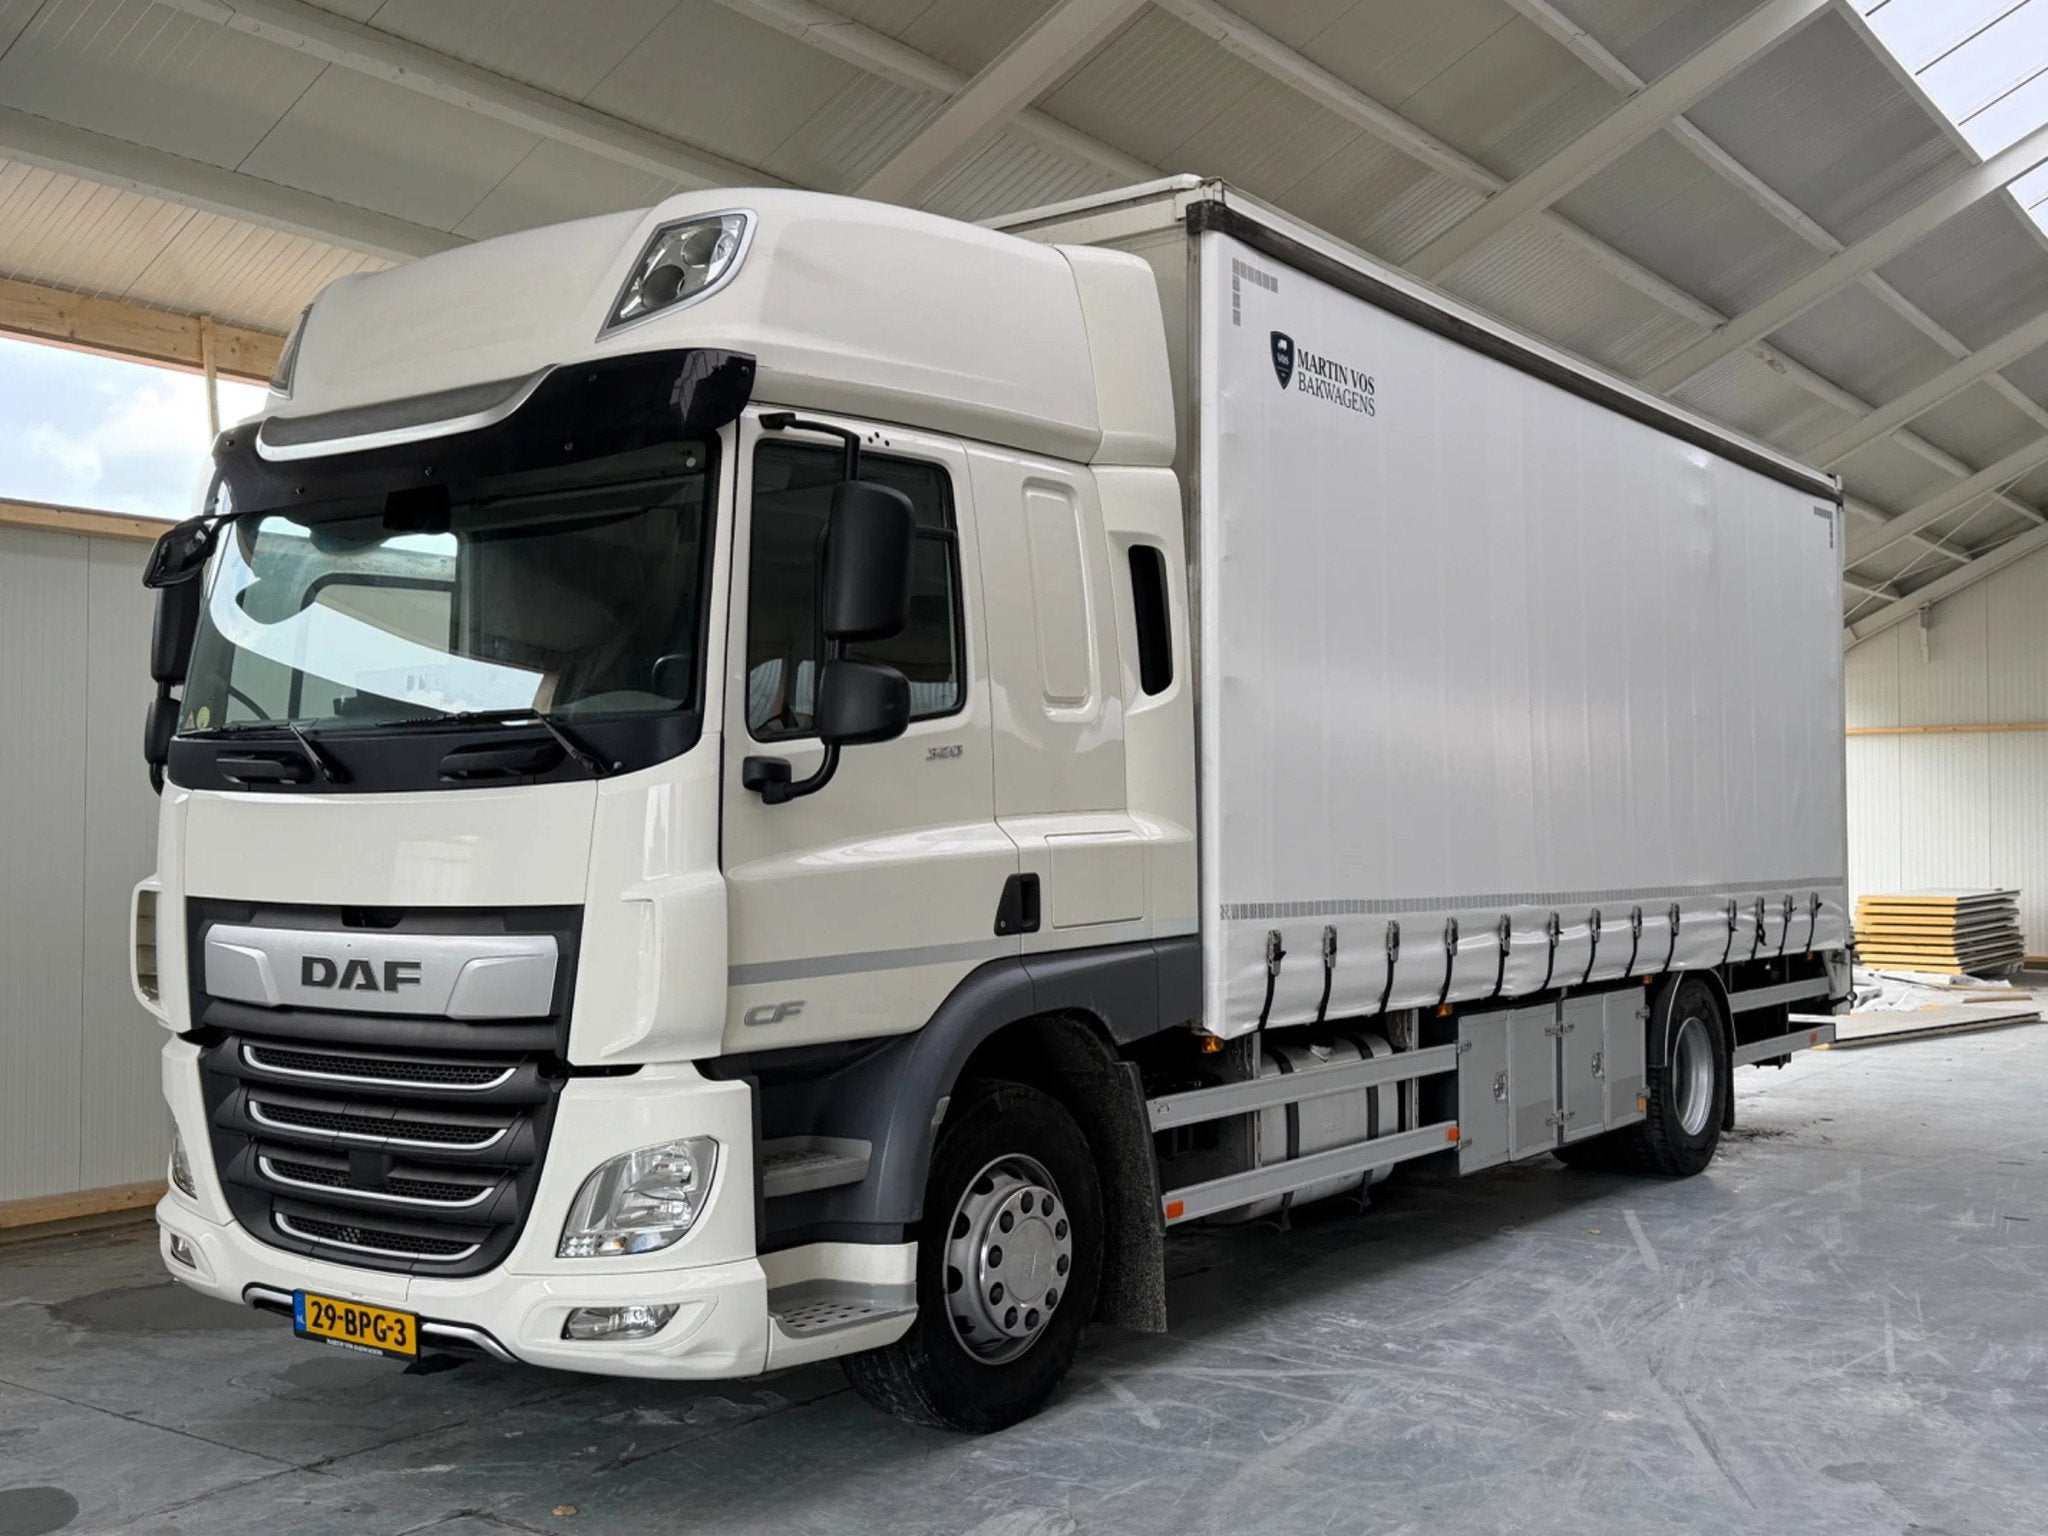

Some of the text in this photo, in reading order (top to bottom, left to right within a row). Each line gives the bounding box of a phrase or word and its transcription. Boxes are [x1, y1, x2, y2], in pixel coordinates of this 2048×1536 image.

[1298, 348, 1375, 395] MARTIN VOS
[1298, 371, 1376, 417] BAKWAGENS
[301, 955, 422, 992] DAF
[743, 1000, 805, 1026] CF
[310, 1301, 406, 1346] 29-BPG-3
